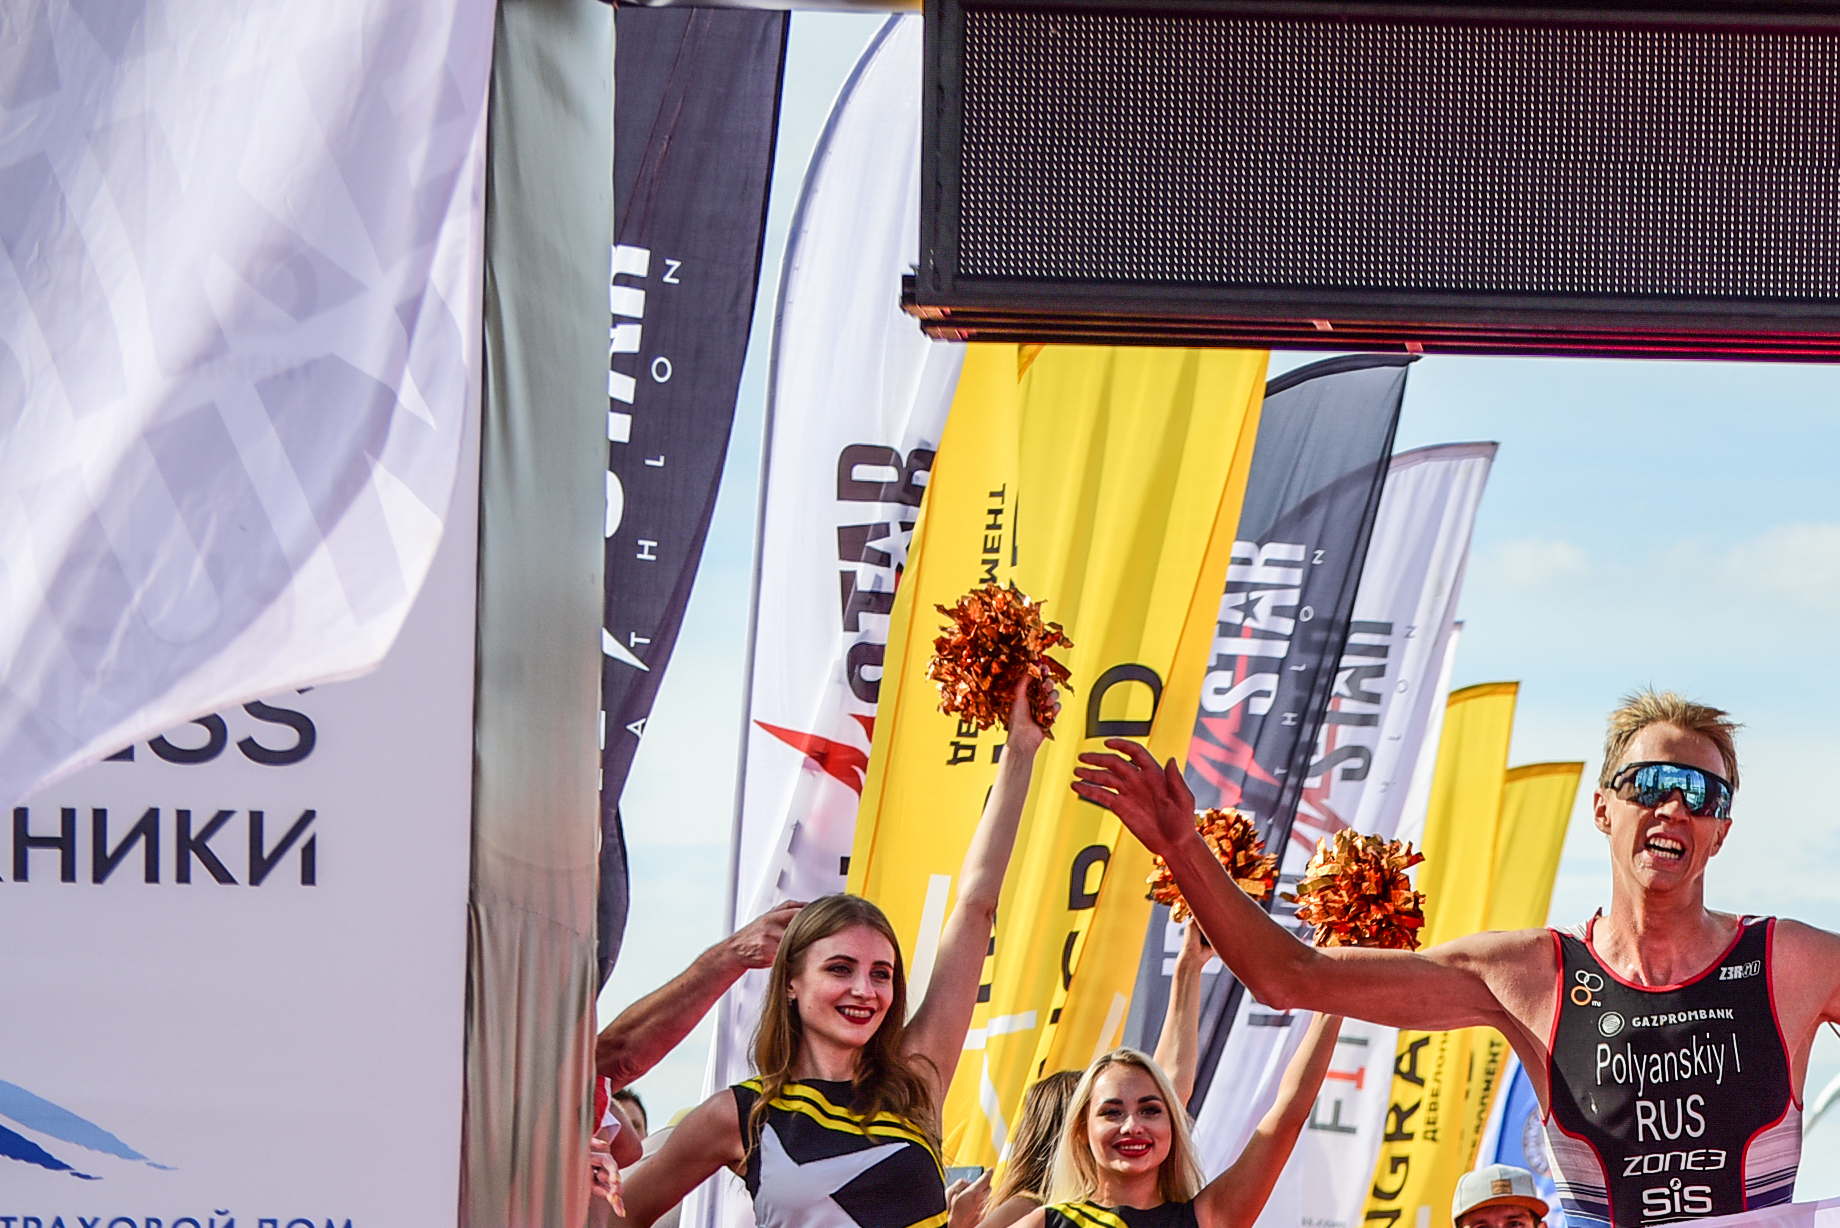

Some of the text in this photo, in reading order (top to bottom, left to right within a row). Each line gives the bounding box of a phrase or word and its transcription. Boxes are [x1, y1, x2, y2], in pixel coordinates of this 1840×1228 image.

[0, 806, 318, 887] НИКИ
[1631, 1008, 1735, 1028] GAZPROMBANK
[1595, 1032, 1726, 1098] Polyanskiy
[1635, 1093, 1706, 1142] RUS
